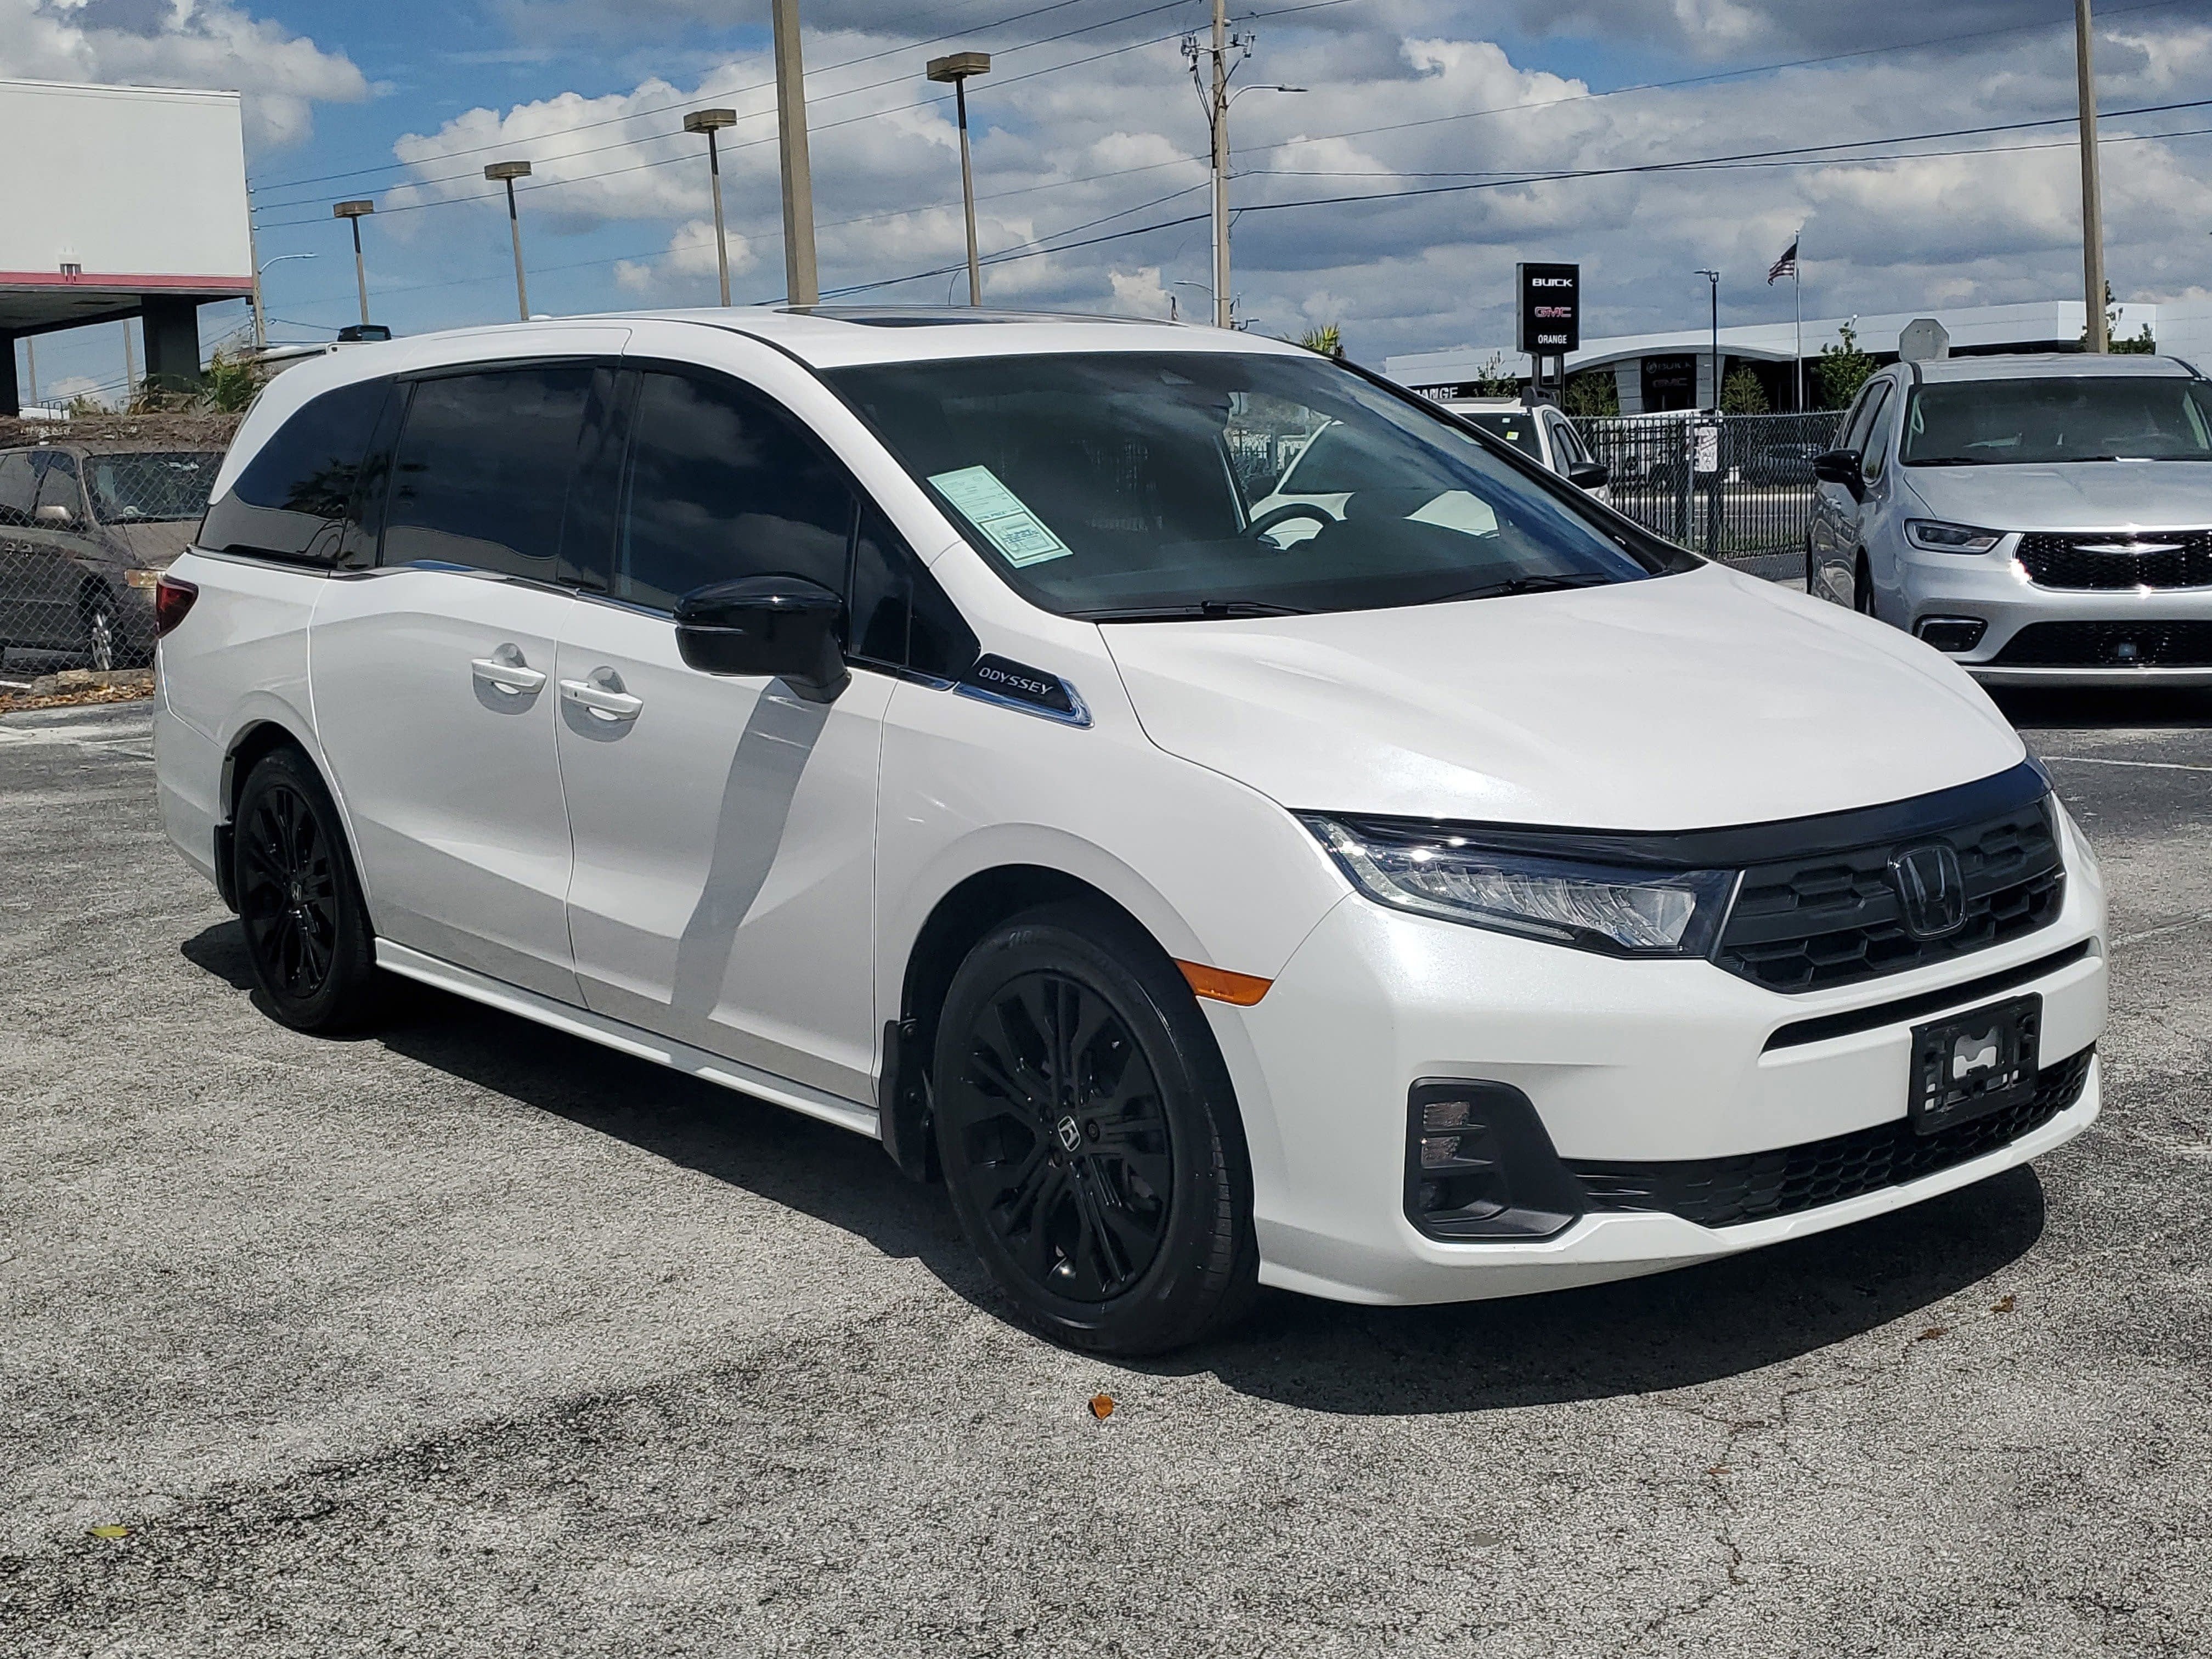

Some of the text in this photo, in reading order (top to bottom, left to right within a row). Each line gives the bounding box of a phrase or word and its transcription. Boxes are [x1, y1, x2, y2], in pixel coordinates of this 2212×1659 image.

[1532, 278, 1573, 287] BUICK
[1534, 306, 1572, 318] GMC
[1538, 334, 1567, 344] ORANGE
[978, 667, 1054, 695] ODYSSEY
